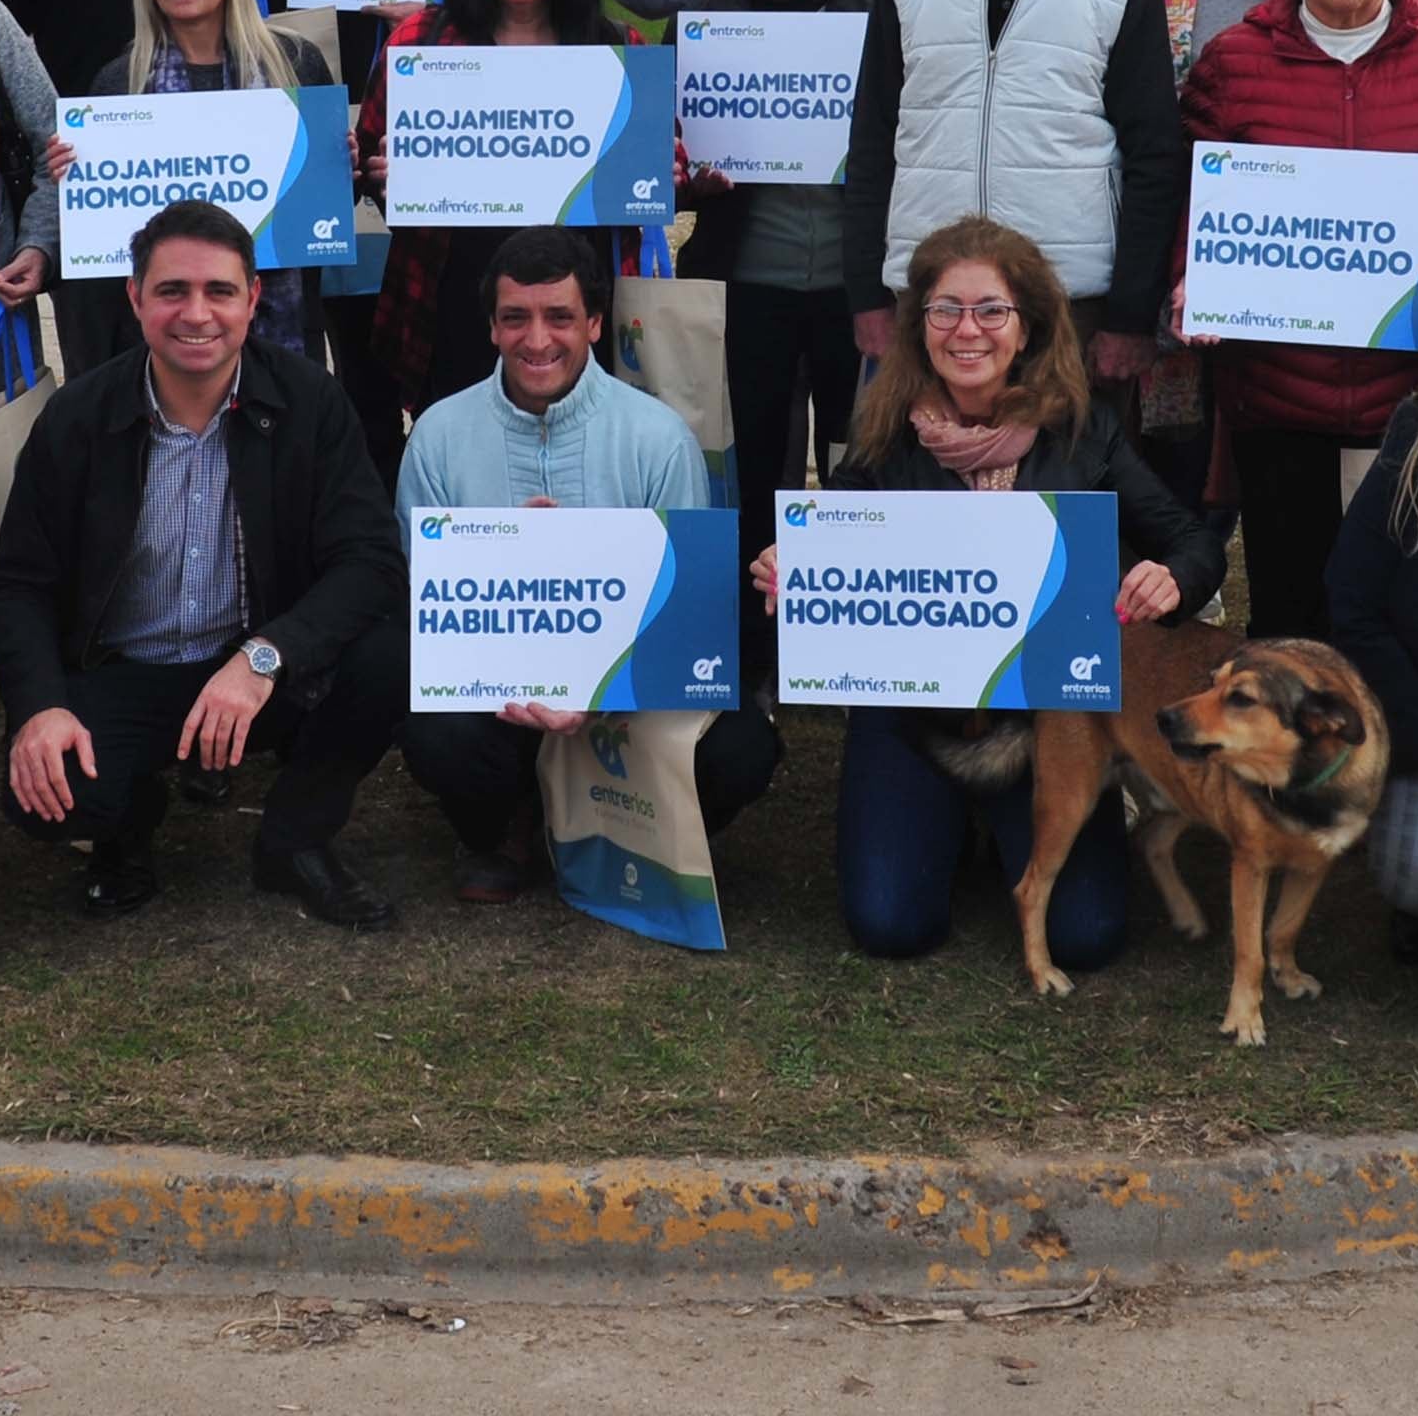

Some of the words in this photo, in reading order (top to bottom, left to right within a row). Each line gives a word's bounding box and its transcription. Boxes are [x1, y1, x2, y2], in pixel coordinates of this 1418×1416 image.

[682, 72, 852, 94] ALOJAMIENTO
[394, 108, 574, 130] ALOJAMIENTO
[393, 134, 590, 158] HOMOLOGADO
[64, 153, 250, 182] ALOJAMIENTO
[66, 178, 268, 210] HOMOLOGADO
[1197, 211, 1396, 244] ALOJAMIENTO
[1194, 238, 1413, 276] HOMOLOGADO
[420, 577, 626, 602] ALOJAMIENTO
[786, 567, 998, 595] ALOJAMIENTO
[418, 607, 602, 634] HABILITADO
[785, 598, 1018, 629] HOMOLOGADO
